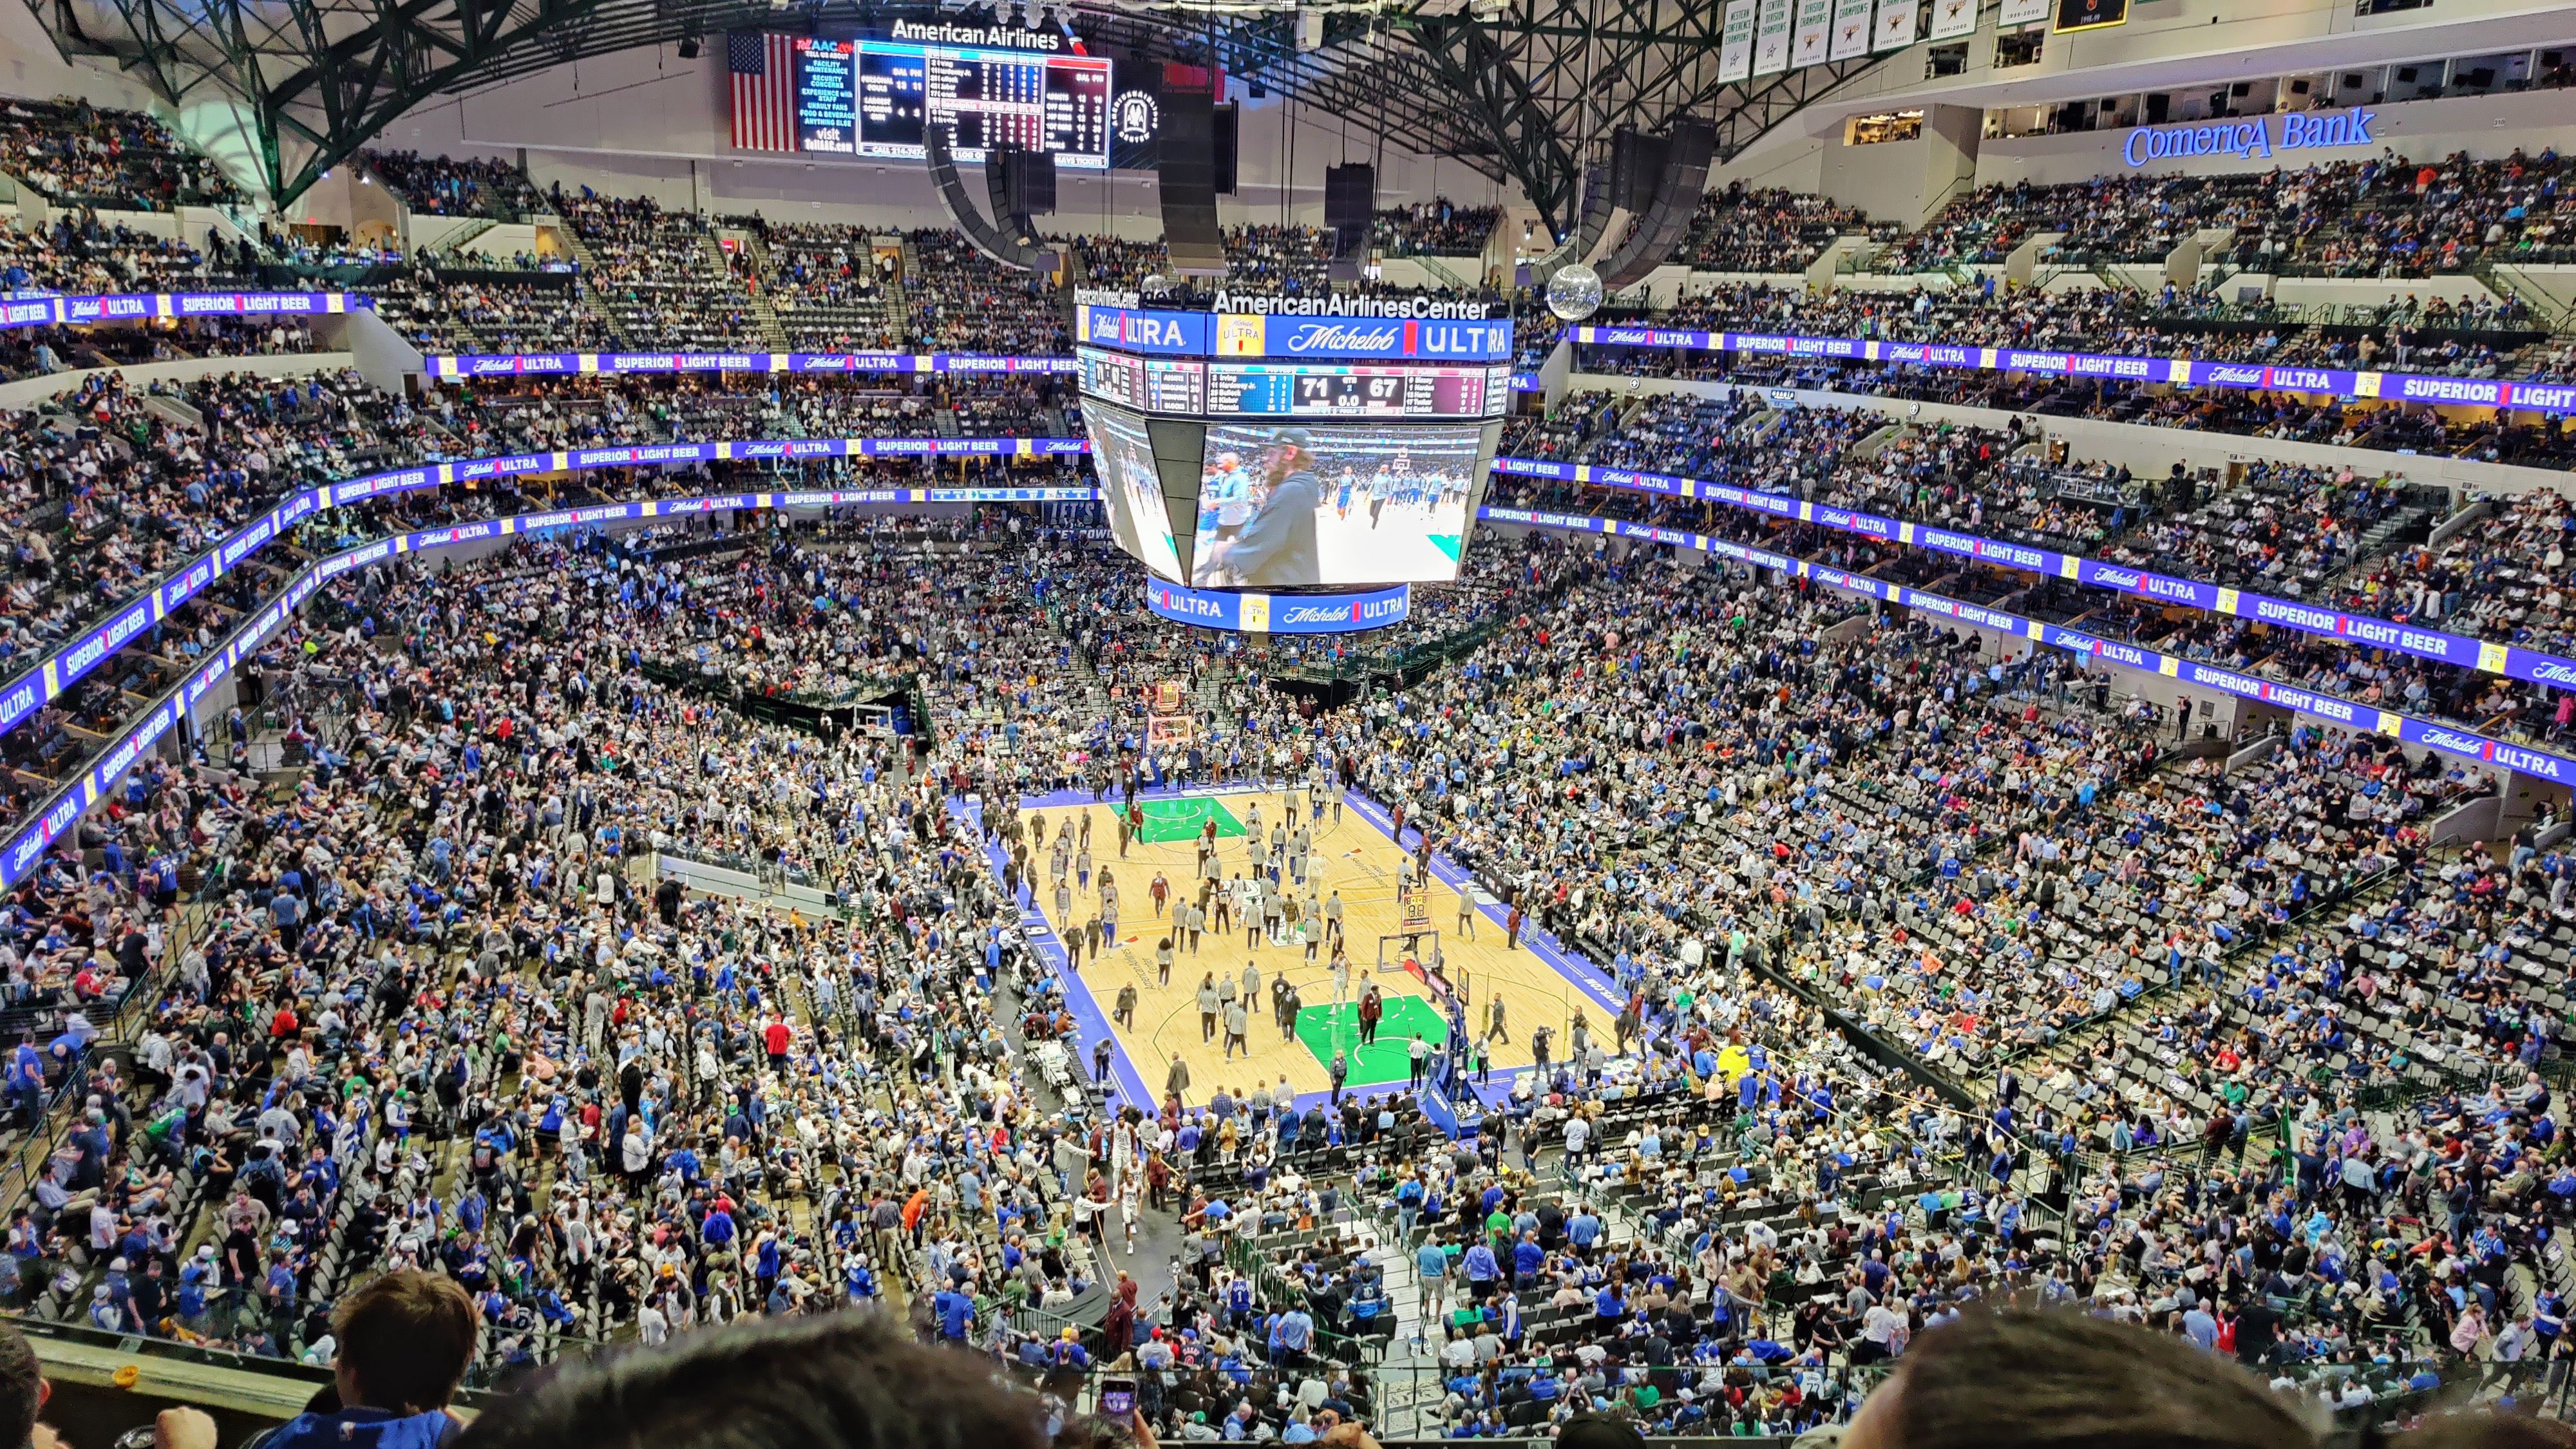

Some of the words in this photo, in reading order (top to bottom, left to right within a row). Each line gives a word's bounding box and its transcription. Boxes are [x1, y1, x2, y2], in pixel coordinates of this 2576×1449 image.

[1730, 9, 1749, 21] WESTERN
[1804, 1, 1825, 14] DIVISION
[1839, 3, 1868, 19] CHAMPIONS
[1725, 19, 1752, 32] CONFERENCE
[1766, 11, 1785, 23] DIVISION
[1800, 13, 1826, 27] CHAMPIONS
[1761, 22, 1786, 36] CHAMPIONS
[1725, 32, 1748, 45] CHAMPIONS
[816, 128, 840, 141] visit
[2280, 106, 2376, 149] Bank
[8, 305, 28, 322] LIGHT
[29, 304, 47, 320] BEER
[71, 299, 100, 317] Michelob
[108, 299, 146, 314] ULTRA
[182, 297, 235, 311] SUPERIOR
[244, 298, 278, 310] LIGHT
[281, 297, 310, 310] BEER
[1094, 314, 1119, 339] Michelob
[1126, 317, 1184, 346] ULTRA
[1224, 328, 1259, 340] ULTRA
[1289, 324, 1399, 352] Michelob
[1426, 327, 1506, 353] ULTRA
[1608, 331, 1645, 343] Michelob
[1654, 332, 1693, 345] ULTRA
[1736, 337, 1785, 350] SUPERIOR
[1793, 339, 1824, 352] LIGHT
[1826, 341, 1852, 355] BEER
[1890, 345, 1922, 360] Michelob
[1931, 348, 1965, 363] ULTRA
[473, 359, 513, 372] Michelob
[523, 357, 563, 370] ULTRA
[614, 356, 673, 368] SUPERIOR
[681, 356, 715, 368] LIGHT
[719, 355, 750, 368] BEER
[804, 357, 846, 368] Michelob
[855, 357, 898, 368] ULTRA
[949, 359, 1006, 369] SUPERIOR
[1014, 359, 1048, 370] LIGHT
[1051, 359, 1079, 370] BEER
[2011, 354, 2066, 370] SUPERIOR
[2076, 358, 2112, 374] LIGHT
[2115, 361, 2148, 375] BEER
[2208, 366, 2260, 383] Michelob
[2274, 370, 2330, 388] ULTRA
[1303, 378, 1327, 397] 71
[1370, 378, 1397, 397] 67
[2404, 379, 2496, 401] SUPERIOR
[2513, 386, 2575, 407] LIGHT
[1338, 395, 1359, 407] 0.0
[746, 444, 784, 455] Michelob
[793, 442, 831, 453] ULTRA
[876, 441, 929, 451] SUPERIOR
[938, 441, 969, 451] LIGHT
[971, 441, 998, 451] BEER
[1045, 442, 1082, 451] Michelob
[581, 451, 630, 464] SUPERIOR
[638, 448, 670, 460] LIGHT
[673, 447, 699, 458] BEER
[463, 462, 493, 477] Michelob
[502, 458, 539, 471] ULTRA
[1507, 460, 1534, 473] LIGHT
[1536, 463, 1560, 475] BEER
[338, 481, 372, 500] SUPERIOR
[374, 475, 399, 491] LIGHT
[401, 472, 425, 486] BEER
[1602, 471, 1633, 484] Michelob
[1639, 477, 1669, 489] ULTRA
[670, 501, 702, 513] Michelob
[711, 498, 743, 507] ULTRA
[785, 495, 833, 504] SUPERIOR
[840, 492, 869, 501] LIGHT
[870, 491, 895, 500] BEER
[1705, 486, 1742, 501] SUPERIOR
[1747, 493, 1768, 507] LIGHT
[1768, 497, 1788, 512] BEER
[526, 515, 571, 528] SUPERIOR
[578, 509, 603, 521] LIGHT
[605, 507, 627, 518] BEER
[1489, 508, 1531, 521] SUPERIOR
[1539, 513, 1564, 526] LIGHT
[1566, 516, 1589, 528] BEER
[1821, 510, 1850, 526] Michelob
[1856, 518, 1887, 534] ULTRA
[419, 531, 451, 546] Michelob
[459, 525, 489, 539] ULTRA
[1625, 525, 1651, 538] Michelob
[1657, 531, 1685, 544] ULTRA
[1715, 542, 1745, 558] SUPERIOR
[1749, 551, 1769, 565] LIGHT
[1768, 554, 1787, 569] BEER
[1925, 531, 1974, 553] SUPERIOR
[1981, 541, 2011, 561] LIGHT
[2014, 549, 2042, 567] BEER
[1817, 569, 1843, 585] Michelob
[1848, 577, 1876, 593] ULTRA
[2094, 567, 2137, 587] Michelob
[2148, 578, 2196, 600] ULTRA
[1171, 596, 1222, 617] ULTRA
[1283, 606, 1351, 623] Michelob
[1364, 598, 1402, 618] ULTRA
[1909, 593, 1953, 614] SUPERIOR
[1958, 603, 1985, 622] LIGHT
[1987, 612, 2012, 630] BEER
[2258, 601, 2334, 630] SUPERIOR
[2347, 621, 2398, 644] LIGHT
[2401, 631, 2447, 655] BEER
[66, 636, 104, 676] SUPERIOR
[108, 620, 129, 648] LIGHT
[128, 608, 146, 636] BEER
[2056, 632, 2095, 651] Michelob
[2102, 647, 2143, 665] ULTRA
[2194, 668, 2259, 694] SUPERIOR
[2269, 684, 2312, 709] LIGHT
[2315, 700, 2353, 721] BEER
[0, 685, 34, 723] ULTRA
[2421, 729, 2479, 755] Michelob
[2496, 747, 2558, 777] ULTRA
[103, 744, 135, 783] SUPERIOR
[14, 826, 43, 871] Michelob
[48, 797, 77, 835] ULTRA
[1237, 1291, 1242, 1303] 1
